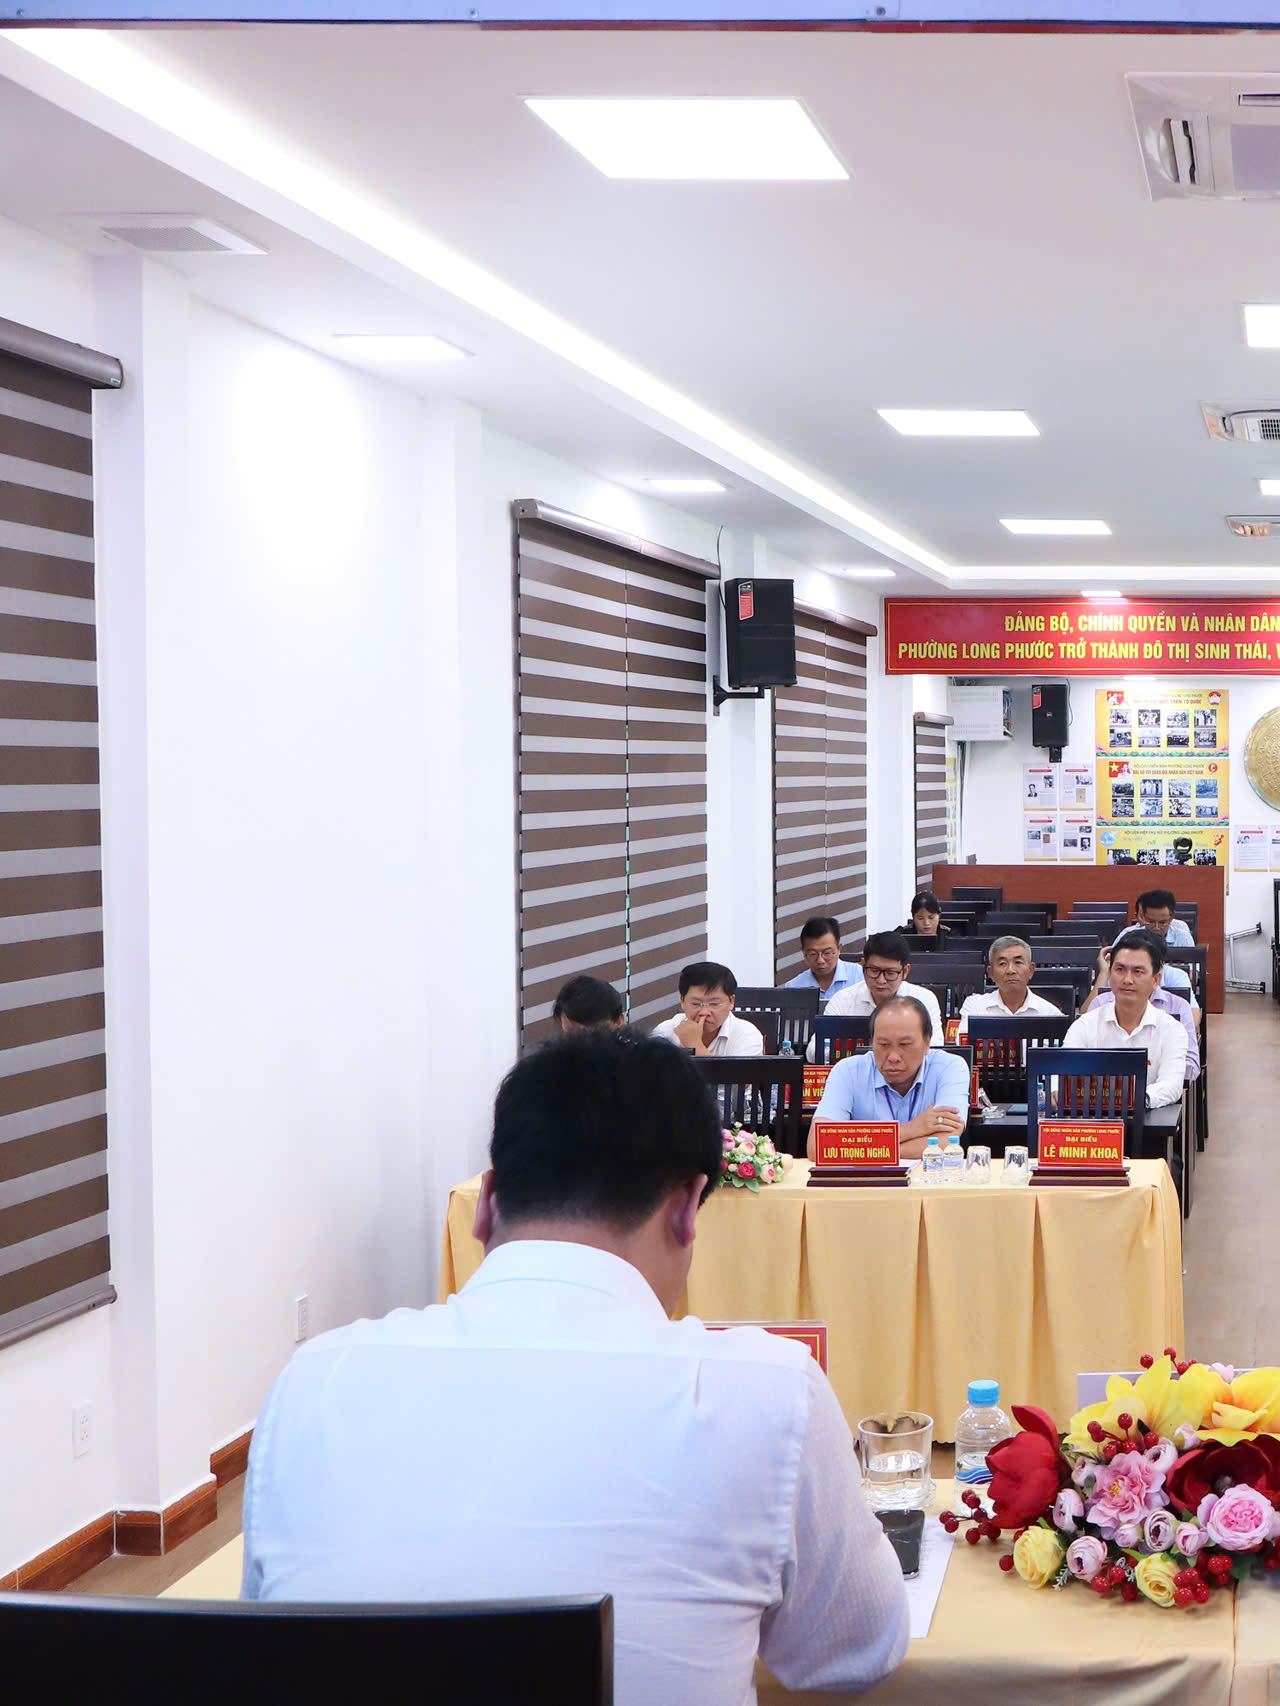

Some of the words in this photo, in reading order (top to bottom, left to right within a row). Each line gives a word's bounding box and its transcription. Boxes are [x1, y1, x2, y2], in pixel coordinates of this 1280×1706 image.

[1004, 611, 1045, 632] ĐẢNG
[1050, 612, 1074, 635] BỘ,
[1078, 612, 1123, 632] CHÍNH
[1127, 611, 1176, 633] QUYỀN
[1181, 612, 1200, 632] VÀ
[1204, 612, 1246, 632] NHÂN
[1251, 612, 1280, 632] DÂN
[898, 639, 957, 659] PHƯỜNG
[962, 643, 1000, 659] LONG
[1004, 639, 1054, 659] PHƯỚC
[1058, 637, 1087, 659] TRỞ
[1090, 639, 1139, 659] THÀNH
[1143, 639, 1163, 659] ĐÔ
[1167, 643, 1190, 662] THỊ
[1194, 642, 1230, 659] SINH
[1234, 640, 1272, 661] THÁI,
[840, 1147, 864, 1160] TRỌNG
[867, 1146, 890, 1158] NGHĨA
[1044, 1144, 1056, 1157] LÊ
[1059, 1147, 1087, 1158] MINH
[1090, 1147, 1118, 1158] KHOA
